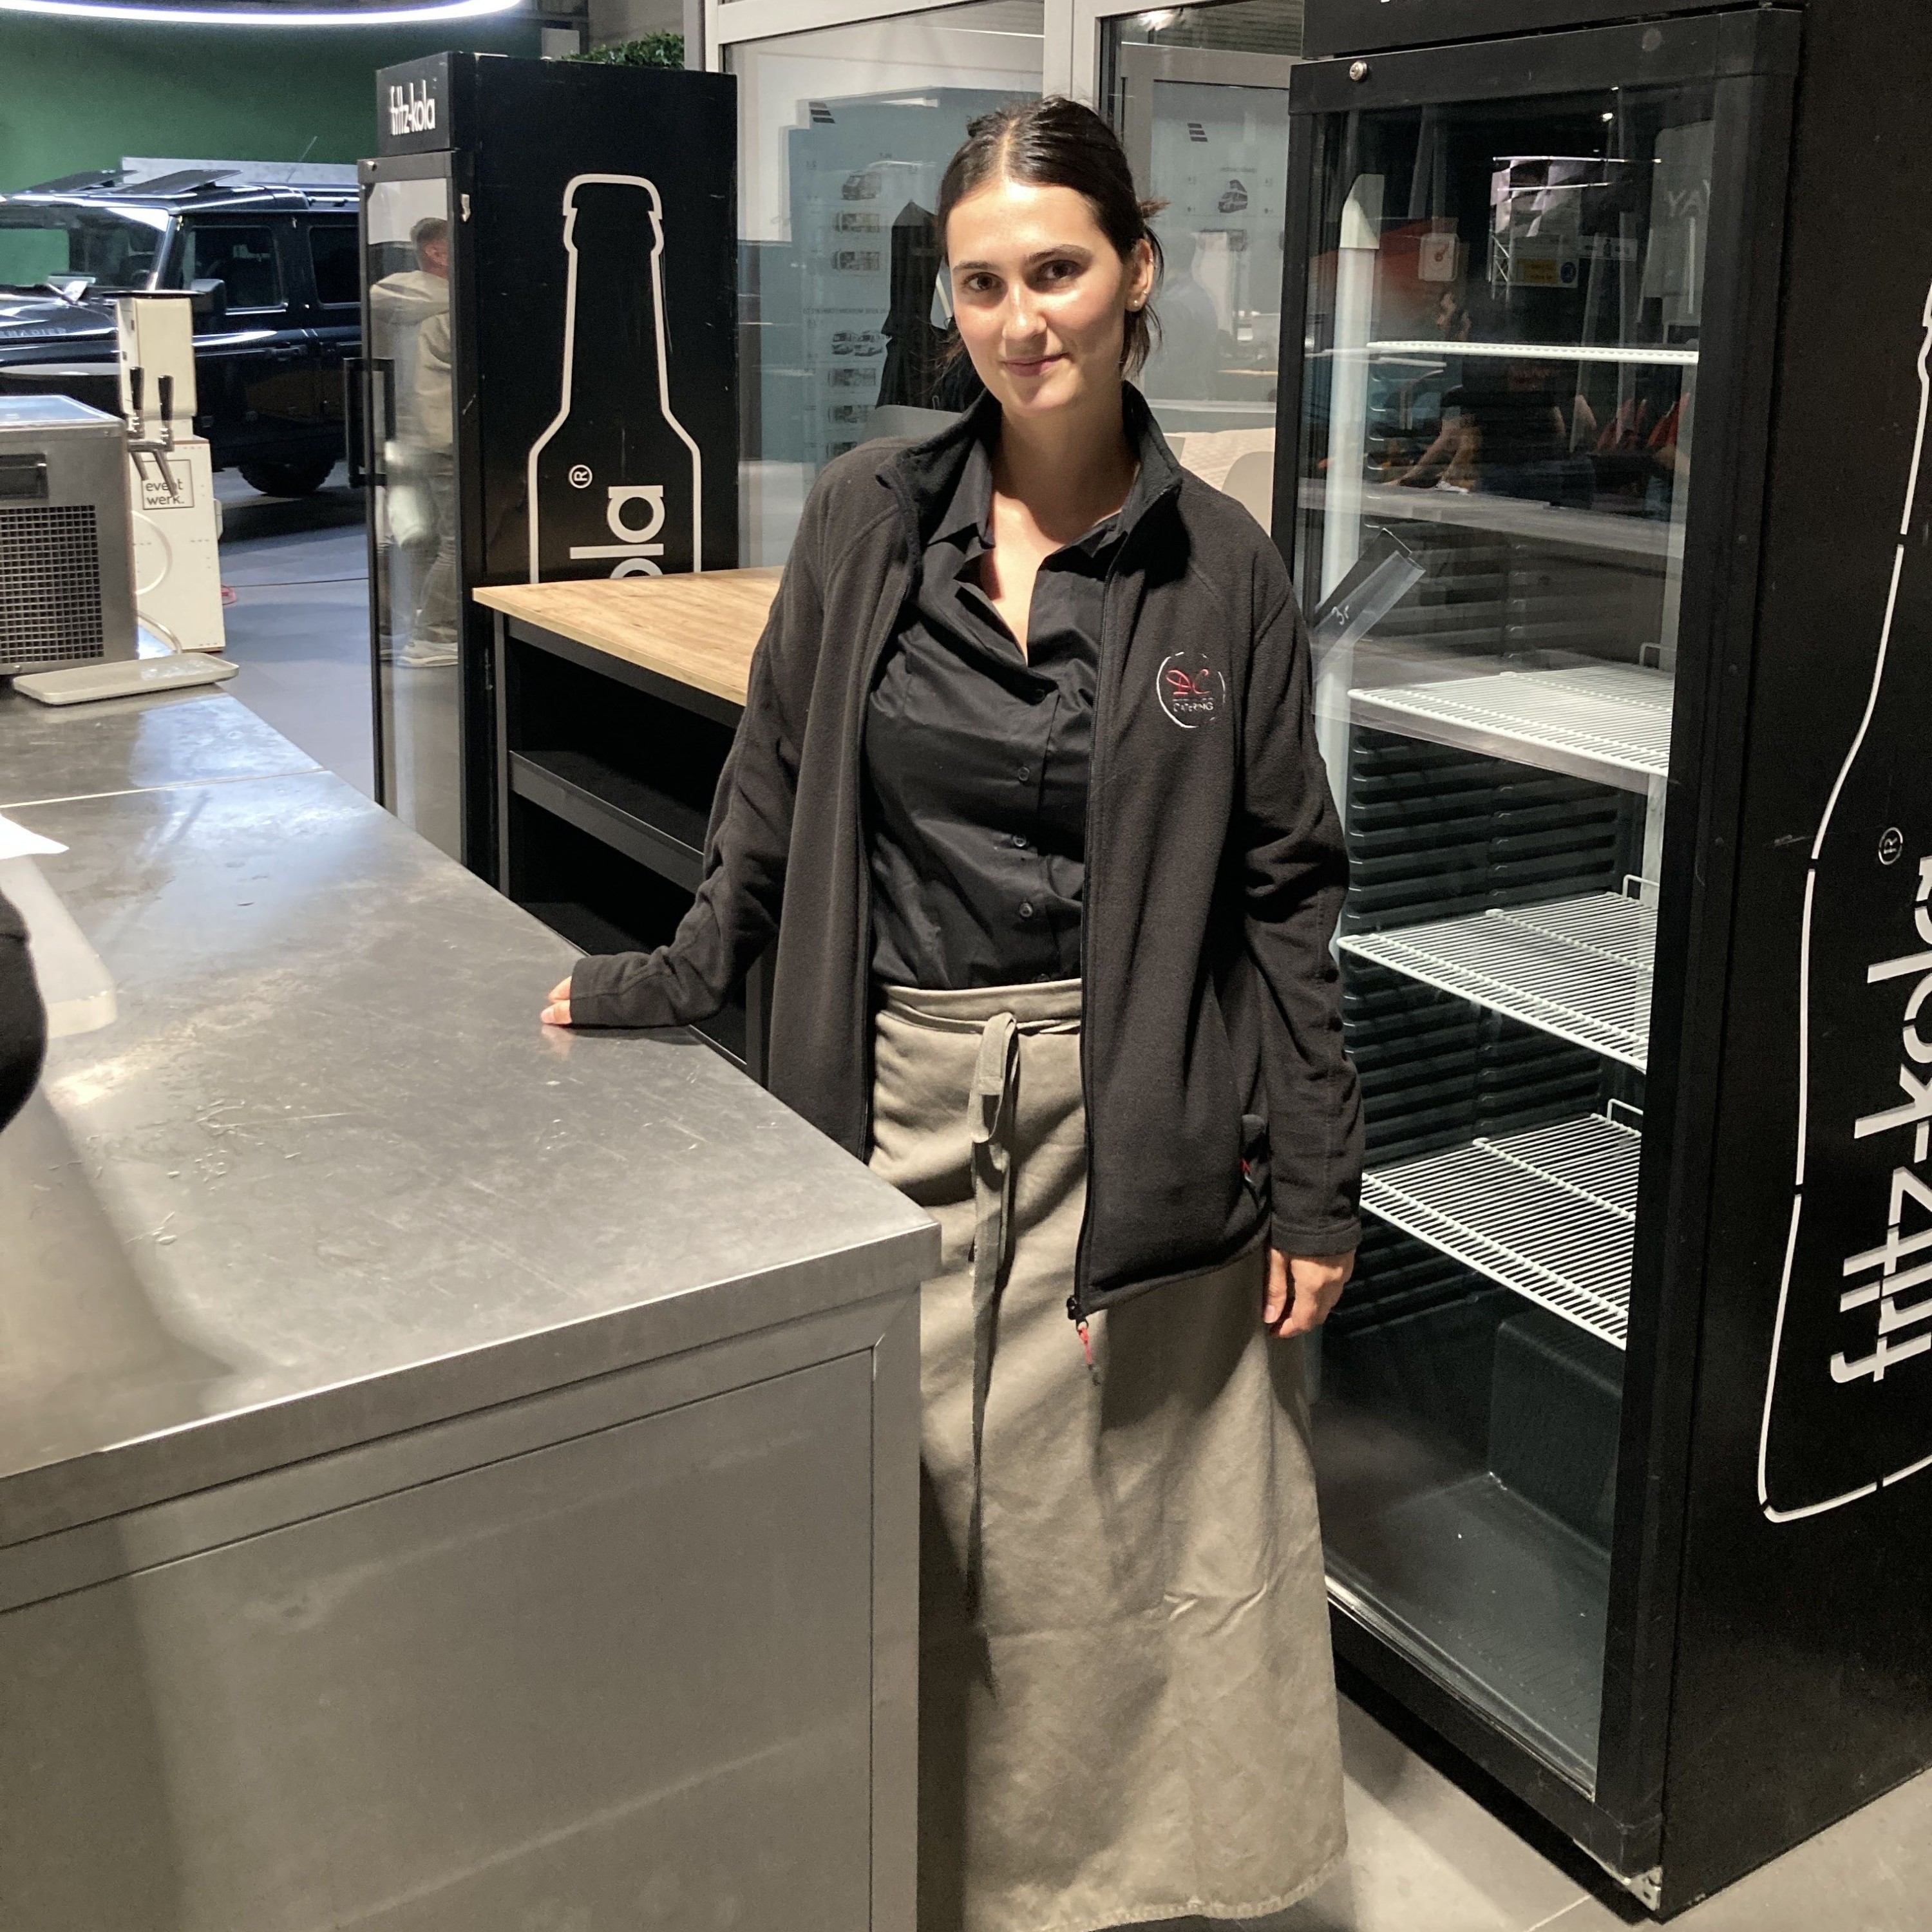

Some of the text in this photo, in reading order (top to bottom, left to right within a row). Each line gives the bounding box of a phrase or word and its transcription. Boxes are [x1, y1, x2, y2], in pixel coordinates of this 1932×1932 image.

[390, 79, 436, 136] fritz-kola
[146, 478, 185, 491] evet
[146, 495, 185, 506] werk.
